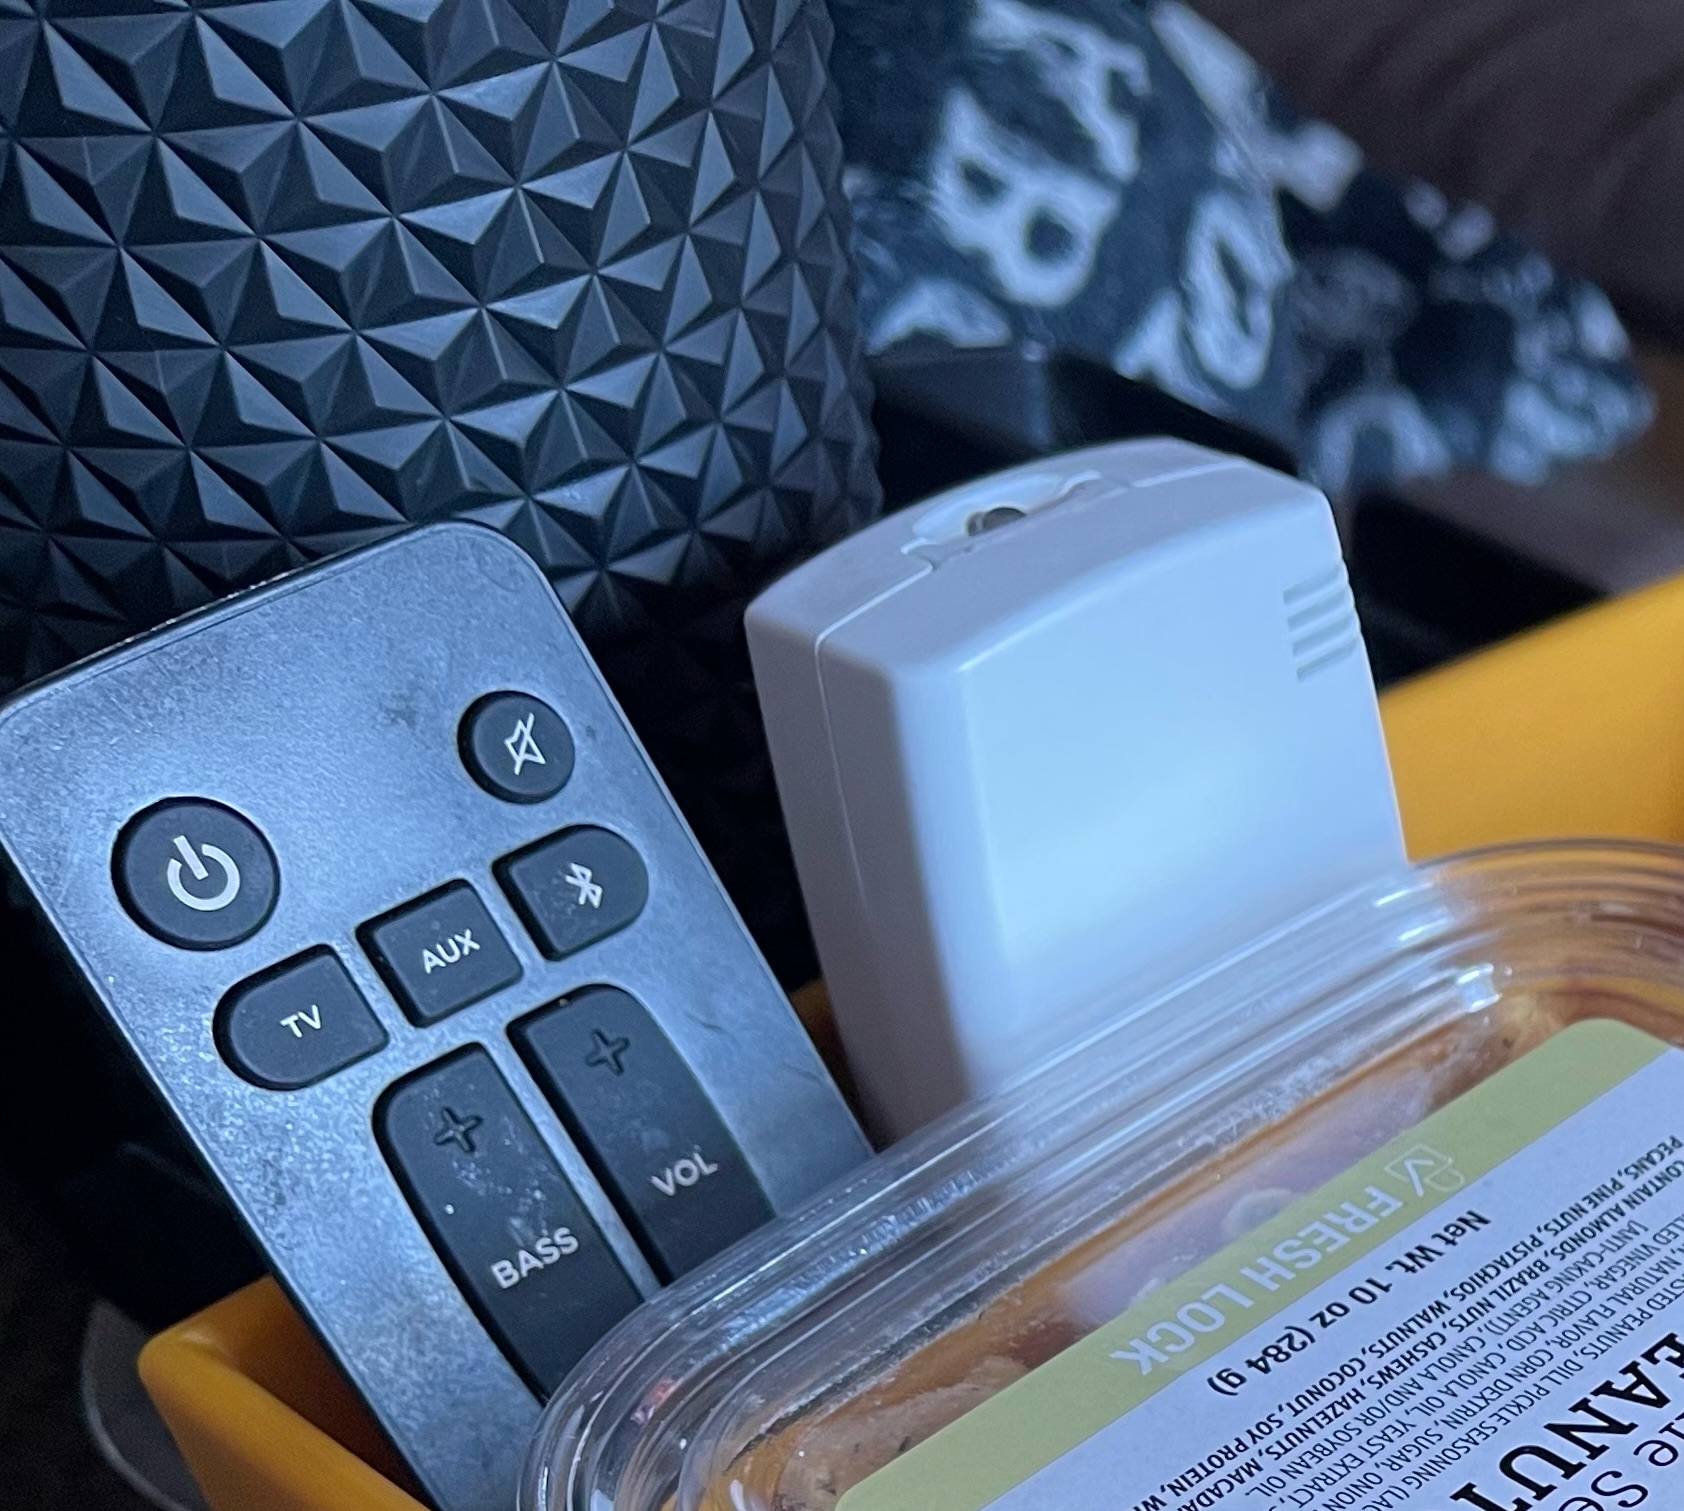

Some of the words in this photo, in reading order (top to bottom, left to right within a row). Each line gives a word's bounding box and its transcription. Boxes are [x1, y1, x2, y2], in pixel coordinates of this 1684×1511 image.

[422, 928, 481, 974] AUX
[280, 1004, 321, 1038] TV
[650, 1152, 718, 1196] VOL
[1615, 1134, 1684, 1181] PECANS,
[1580, 1176, 1625, 1210] PINE
[1238, 1185, 1403, 1291] FRESH
[1430, 1209, 1491, 1247] Net
[1535, 1201, 1589, 1237] NUTS,
[1542, 1201, 1626, 1261] ALMONDS,
[490, 1226, 579, 1289] BASS
[1383, 1243, 1445, 1274] Wt.
[1441, 1233, 1545, 1302] PISTACHIOS,
[1487, 1257, 1551, 1302] BRAZIL
[1582, 1242, 1661, 1291] VINEGAR,
[1604, 1254, 1682, 1306] NATURAL
[1347, 1277, 1393, 1305] 10
[1440, 1295, 1496, 1333] NUTS,
[1536, 1289, 1593, 1328] CITRIC
[1108, 1282, 1254, 1375] LOCK
[1307, 1301, 1351, 1329] oz
[1359, 1299, 1452, 1359] WALNUTS,
[1496, 1320, 1547, 1352] ACID,
[1543, 1302, 1617, 1349] FLAVOR,
[1571, 1305, 1654, 1361] PEANUTS,
[1243, 1324, 1316, 1375] (284
[1358, 1330, 1447, 1390] CASHEWS,
[1415, 1334, 1487, 1381] CANOLA
[1503, 1347, 1554, 1383] CORN
[1538, 1357, 1584, 1386] DILL
[1205, 1367, 1247, 1396] g)
[1276, 1356, 1367, 1418] COCONUT,
[1435, 1351, 1507, 1398] CANOLA
[1256, 1386, 1367, 1461] HAZELNUTS,
[1352, 1376, 1424, 1427] AND/OR
[1403, 1395, 1446, 1417] OIL,
[1432, 1377, 1514, 1430] DEXTRIN,
[1487, 1382, 1551, 1426] PICKLE
[1240, 1412, 1284, 1447] SOY
[1278, 1420, 1363, 1480] SOYBEAN
[1356, 1417, 1417, 1459] YEAST
[1373, 1426, 1444, 1472] SUGAR,
[1158, 1436, 1250, 1497] PROTEIN,
[1400, 1419, 1499, 1490] SEASONING
[1243, 1474, 1287, 1497] OIL.
[1277, 1451, 1366, 1509] EXTRACT,
